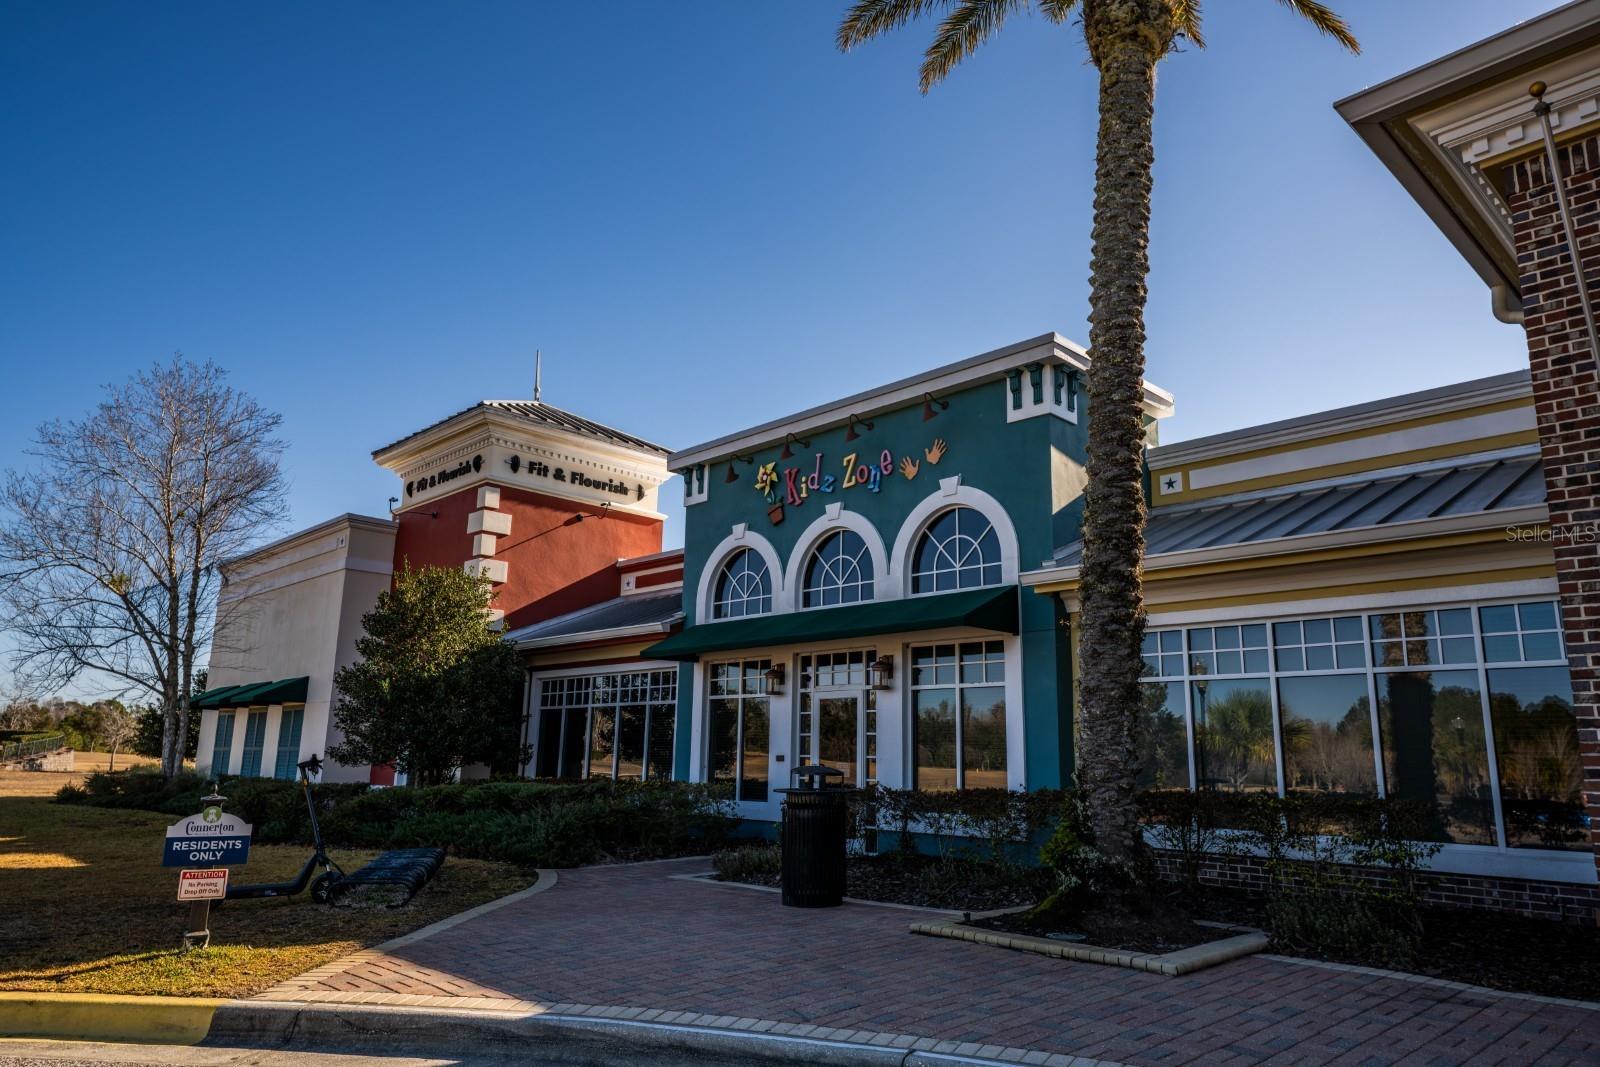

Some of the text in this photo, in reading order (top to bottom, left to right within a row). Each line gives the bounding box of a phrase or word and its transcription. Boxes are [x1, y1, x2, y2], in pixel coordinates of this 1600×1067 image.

[416, 460, 472, 493] Fit & Flourish
[528, 461, 629, 496] Fit & Flourish
[784, 449, 893, 506] Kidz Zone
[186, 821, 234, 835] Connerton
[172, 840, 242, 851] RESIDENTS
[189, 851, 224, 861] ONLY
